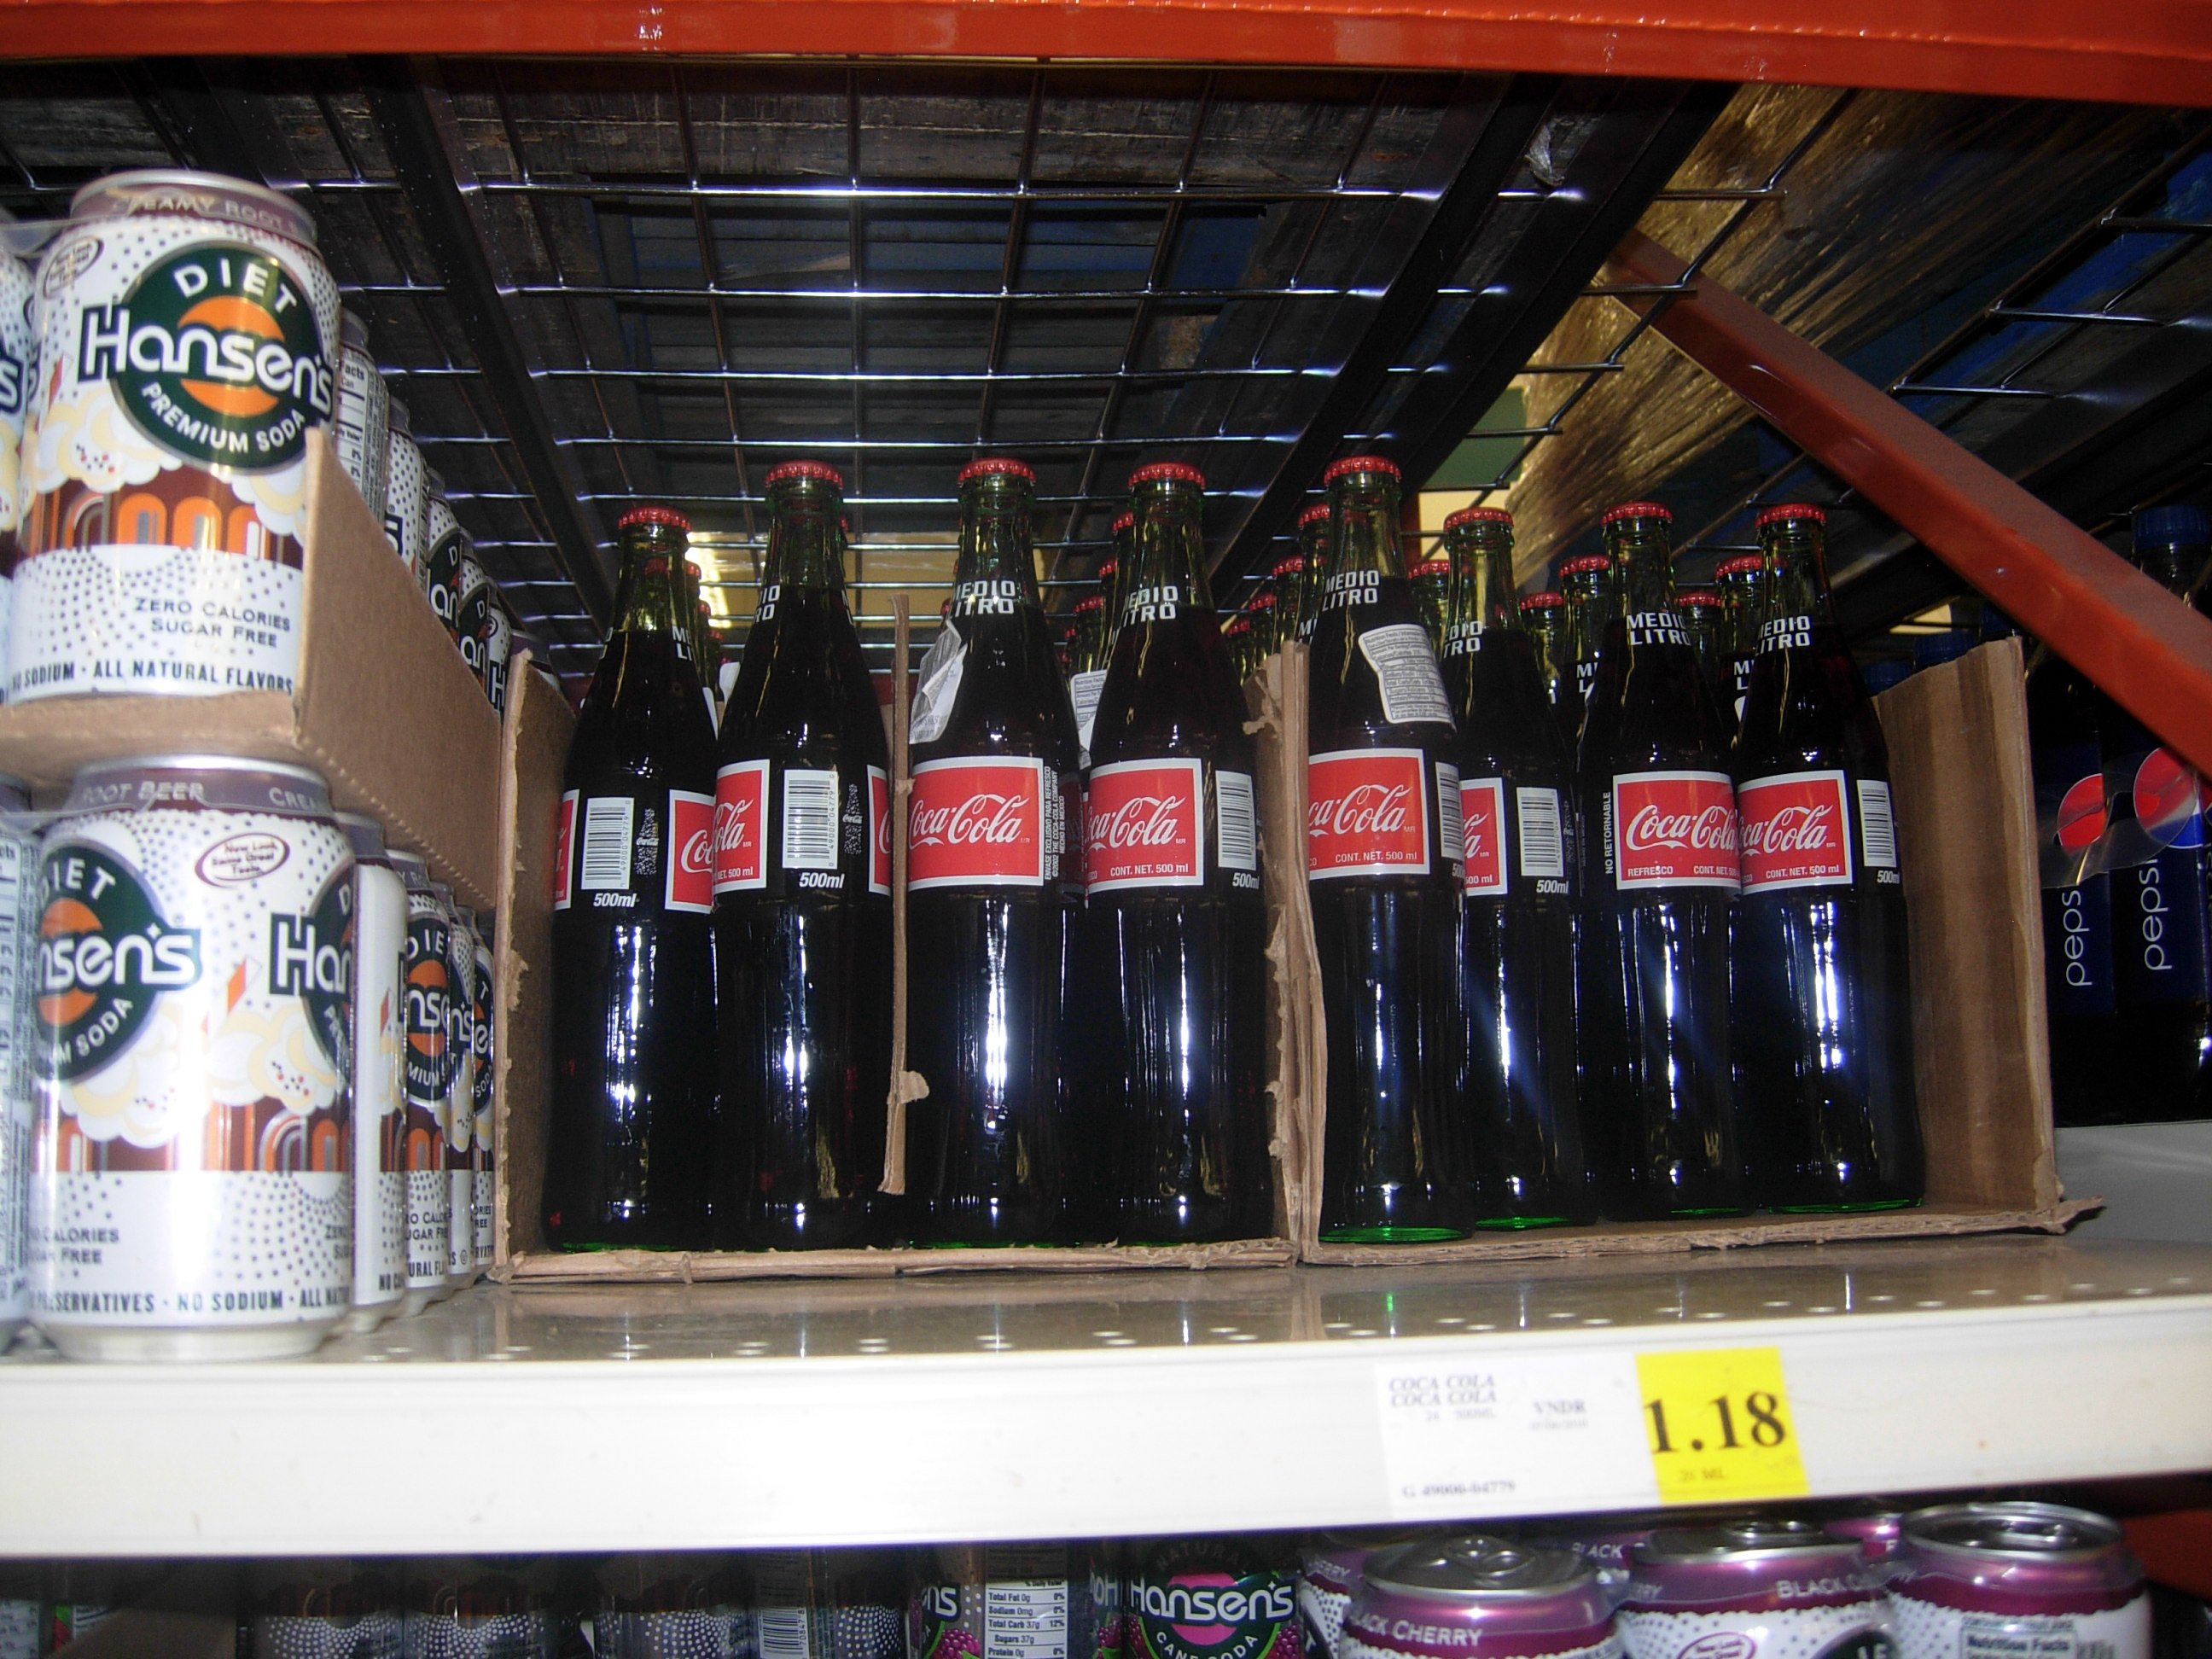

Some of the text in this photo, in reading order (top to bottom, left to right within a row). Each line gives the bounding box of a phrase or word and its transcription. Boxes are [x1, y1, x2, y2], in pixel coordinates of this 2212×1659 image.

[173, 259, 299, 313] DIET
[84, 308, 333, 416] Hansen's
[142, 381, 306, 453] PREMIUM SODA
[1324, 570, 1380, 595] MEDIO
[953, 598, 1015, 618] ITRO
[1322, 587, 1378, 613] LITRO
[135, 597, 291, 632] ZERO CALORIES
[1122, 601, 1176, 627] ITRO
[151, 618, 278, 649] SUGAR FREE
[24, 661, 75, 688] SODIUM
[93, 661, 124, 678] ALL
[132, 661, 219, 684] NATURAL
[226, 667, 294, 696] FLAVORS
[137, 781, 205, 800] BEER
[1603, 791, 1613, 875] NO RETORNABLE
[1335, 850, 1417, 863] CONT. NET. 500 ml
[728, 867, 742, 877] 500
[742, 866, 754, 876] ml
[1110, 863, 1190, 876] CONT. NET. 500 ml
[1481, 873, 1493, 884] ml
[1627, 864, 1674, 877] REFRESCO
[1693, 864, 1715, 876] CONT.
[1765, 864, 1840, 879] CONT. NET. 500 ml
[1877, 870, 1901, 884] 500ml
[799, 872, 846, 889] 500ml
[1231, 872, 1260, 889] 500ml
[1536, 879, 1569, 894] 500ml
[592, 893, 637, 908] 500ml
[2061, 890, 2093, 987] peps
[75, 998, 134, 1057] SODA
[61, 1249, 102, 1264] FREE
[177, 1291, 204, 1312] NO
[212, 1289, 284, 1311] SODIUM
[300, 1288, 322, 1307] ALL
[1389, 1374, 1495, 1393] COCA COLA
[1391, 1390, 1497, 1408] COCA COLA
[1644, 1391, 1788, 1455] 1.18
[988, 1592, 1065, 1604] Total Fat 0g 0%
[1130, 1577, 1294, 1621] Hansen's
[988, 1605, 1016, 1615] Sodium
[1016, 1606, 1033, 1617] 0mg
[988, 1619, 1006, 1628] Total
[1008, 1619, 1025, 1628] Carb
[1026, 1620, 1040, 1630] 37g
[1393, 1620, 1484, 1647] CHERRY
[994, 1633, 1035, 1644] Sugars 37g
[988, 1646, 1014, 1656] Protein
[1015, 1647, 1025, 1658] 0g
